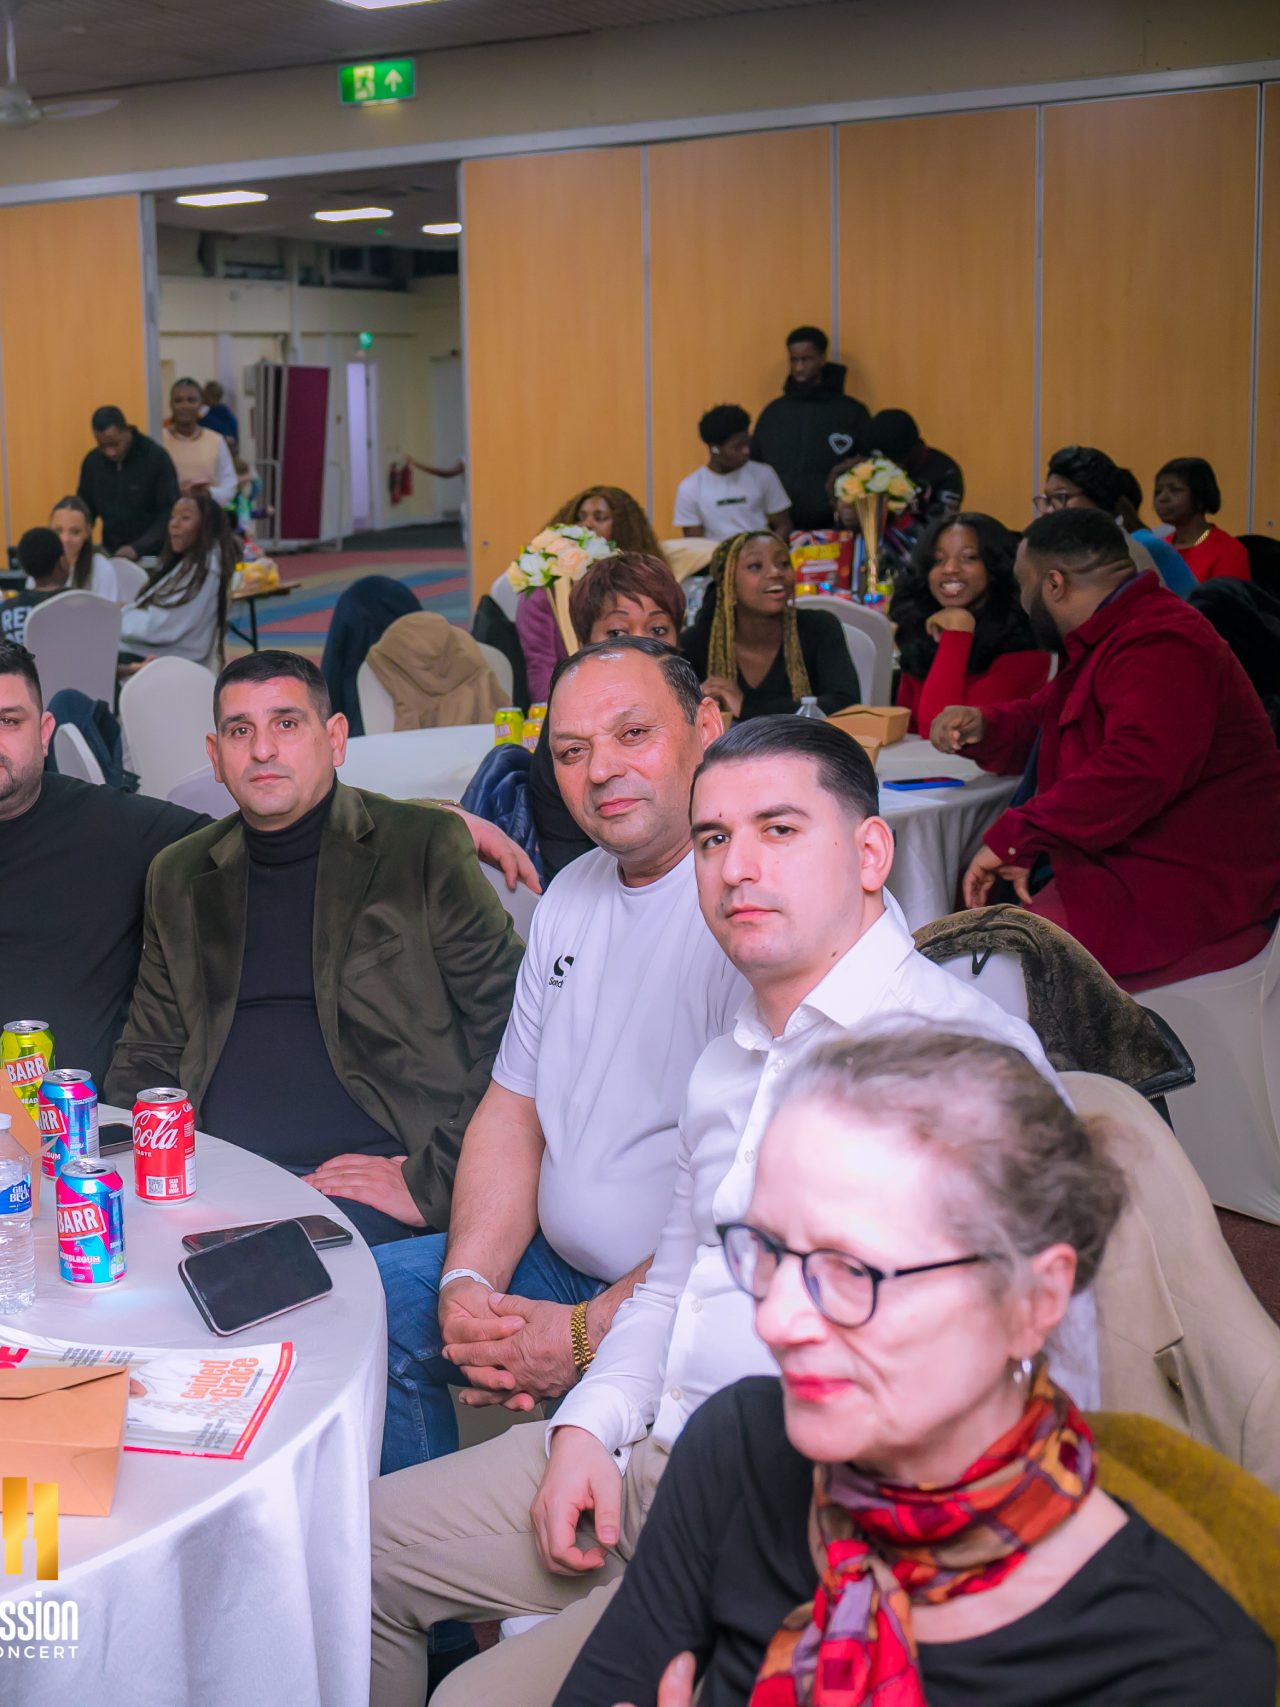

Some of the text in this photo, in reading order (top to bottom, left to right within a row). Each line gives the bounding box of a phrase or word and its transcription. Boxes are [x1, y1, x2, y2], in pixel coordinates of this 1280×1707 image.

[1, 606, 32, 632] RE
[6, 1056, 48, 1083] BARR
[132, 1109, 182, 1150] Cola
[57, 1207, 99, 1233] BARR
[180, 1359, 231, 1399] Guided
[208, 1357, 260, 1399] Grace
